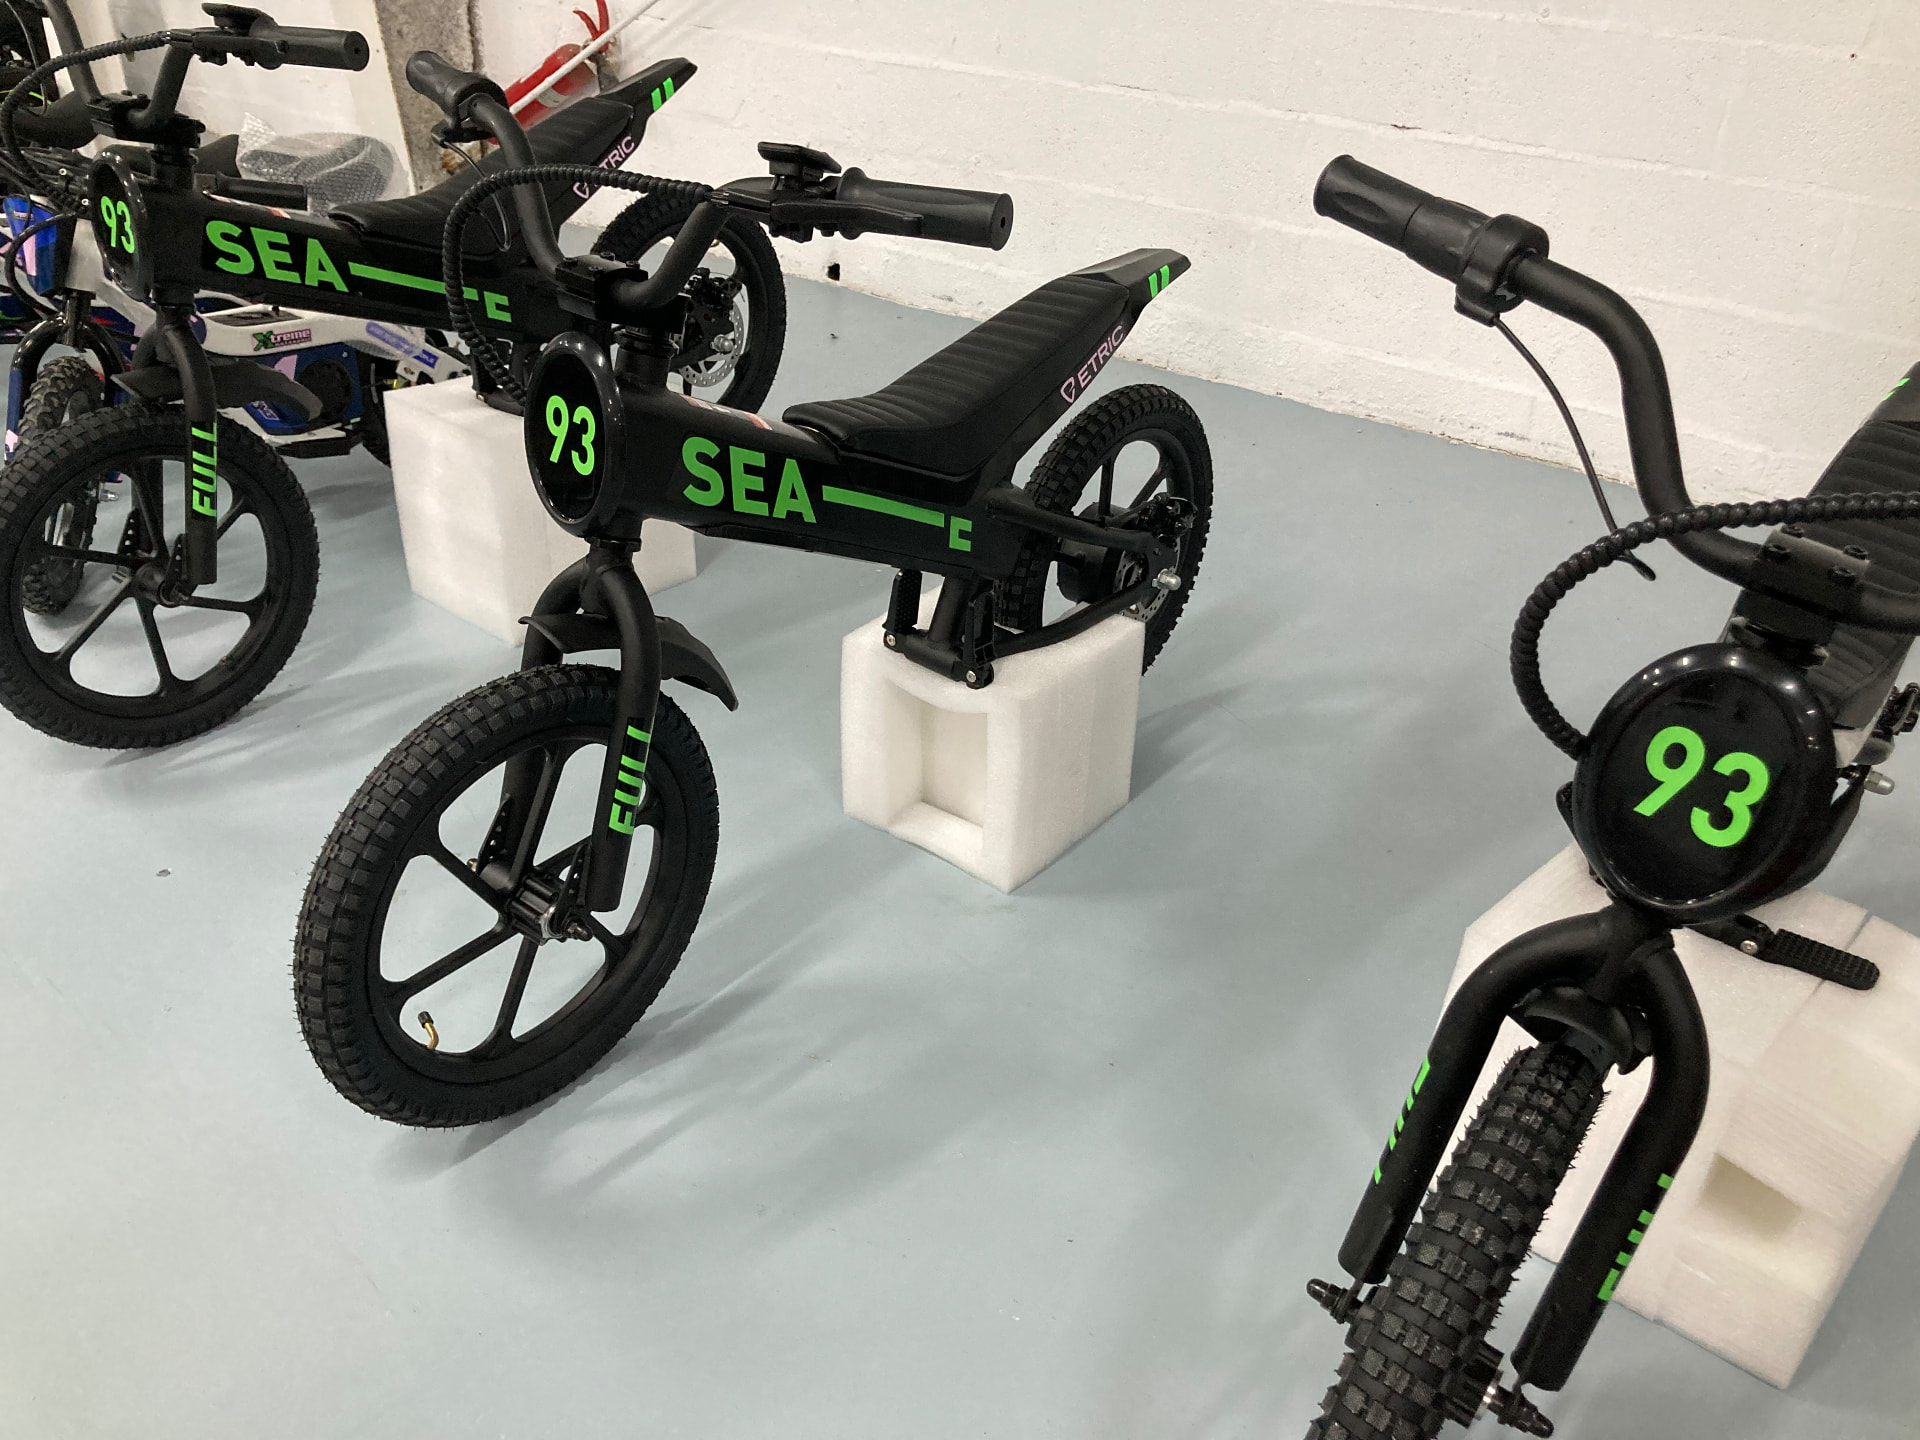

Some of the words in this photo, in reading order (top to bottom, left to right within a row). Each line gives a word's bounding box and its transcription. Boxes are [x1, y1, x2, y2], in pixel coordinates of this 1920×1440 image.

[101, 196, 135, 253] 93
[205, 221, 348, 292] SEA
[192, 422, 217, 517] FULL
[546, 395, 597, 476] 93
[682, 436, 817, 523] SEA
[1633, 726, 1770, 848] 93
